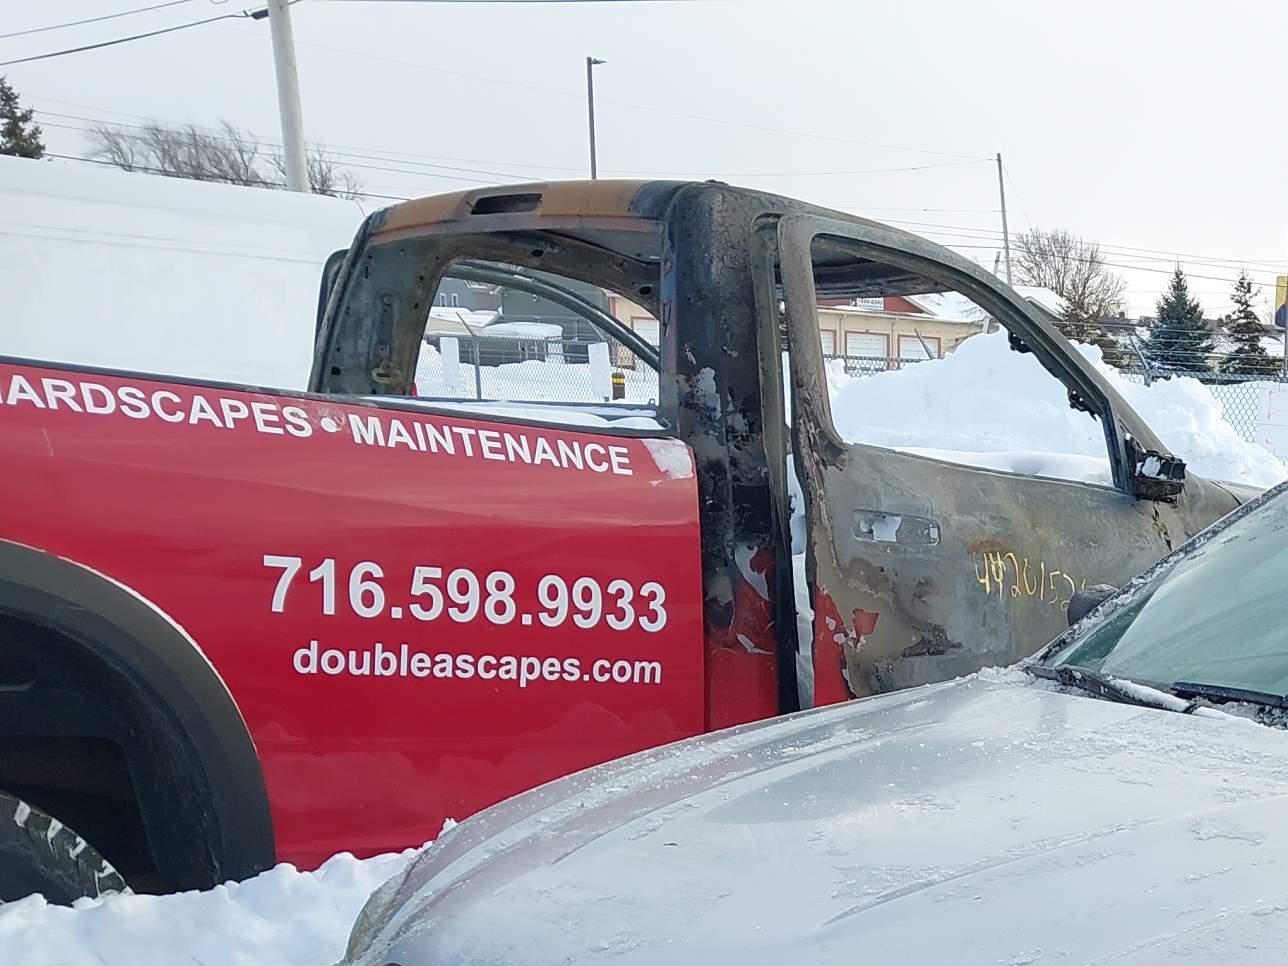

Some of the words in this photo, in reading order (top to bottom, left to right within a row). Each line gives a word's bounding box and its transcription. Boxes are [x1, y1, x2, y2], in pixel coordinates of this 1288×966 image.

[0, 373, 313, 438] ARDSCAPES
[350, 413, 634, 476] MAINTENANCE
[263, 554, 668, 633] 716.598.9933
[293, 640, 662, 688] doubleascapes.com
